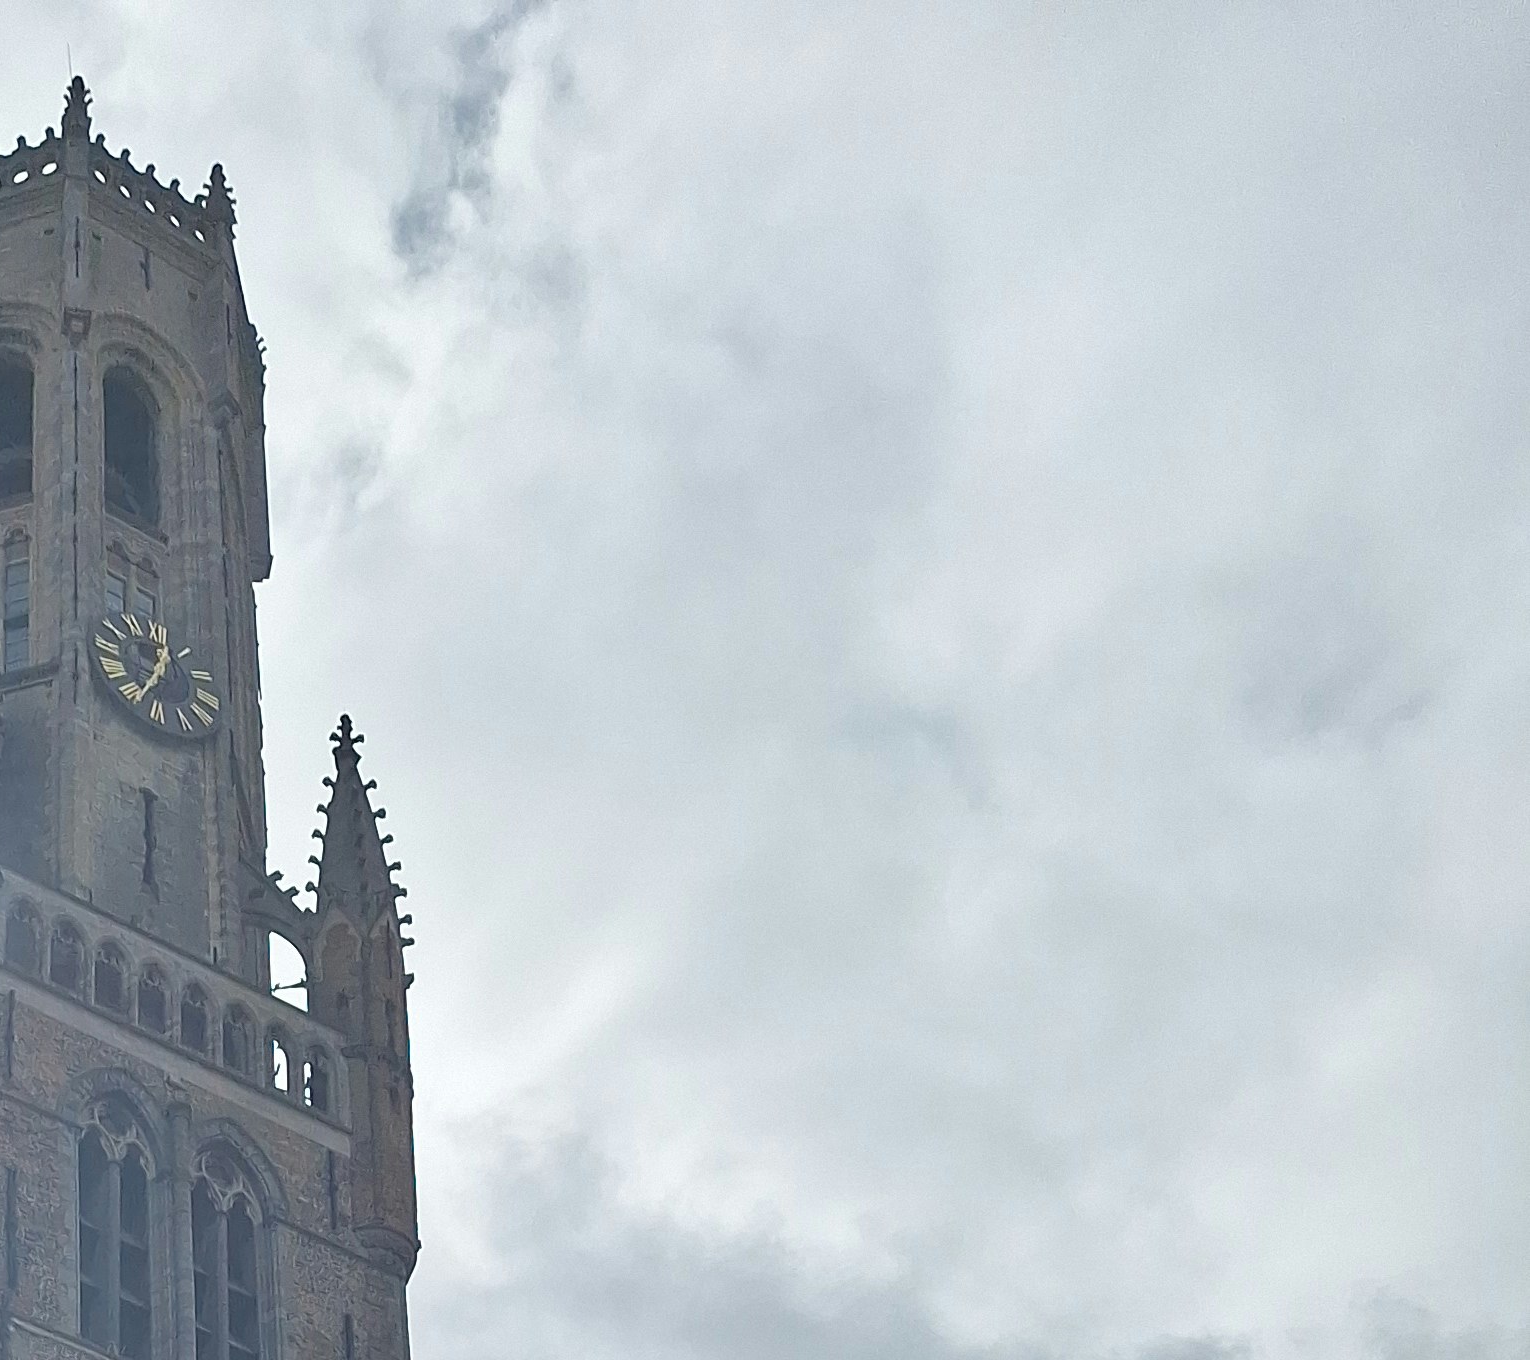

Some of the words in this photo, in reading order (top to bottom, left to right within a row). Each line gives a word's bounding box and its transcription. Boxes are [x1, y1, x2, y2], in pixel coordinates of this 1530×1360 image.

[102, 617, 127, 641] X
[120, 613, 144, 637] XI
[147, 619, 168, 646] XII
[190, 669, 213, 682] II
[196, 688, 220, 711] III
